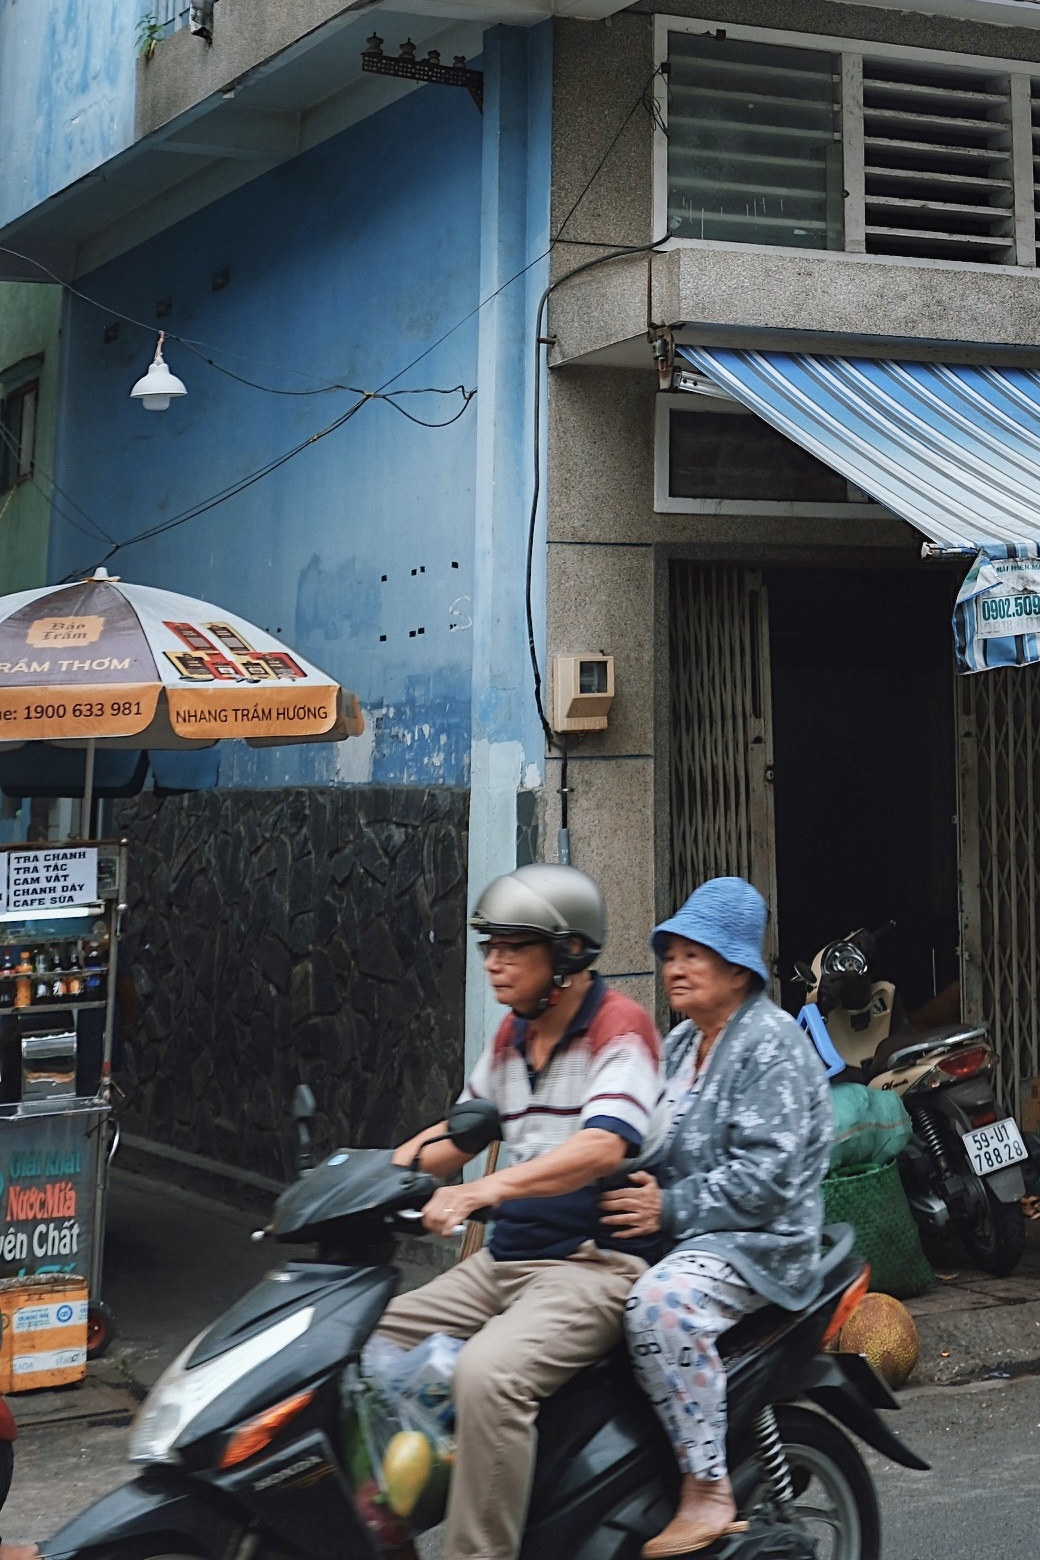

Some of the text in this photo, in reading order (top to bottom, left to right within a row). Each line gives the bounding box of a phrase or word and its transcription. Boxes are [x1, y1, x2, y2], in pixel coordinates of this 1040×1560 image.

[24, 704, 67, 720] 1900
[72, 703, 105, 718] 633
[110, 702, 143, 717] 981
[176, 709, 228, 723] NHANG
[276, 706, 328, 721] HƯƠNG
[44, 851, 86, 862] CHANH
[14, 877, 40, 886] CAM
[14, 886, 56, 897] CHANH
[13, 898, 45, 908] CAFE
[972, 1124, 1010, 1151] 59-U1
[974, 1141, 1023, 1173] 788.28
[33, 1219, 80, 1258] Chất
